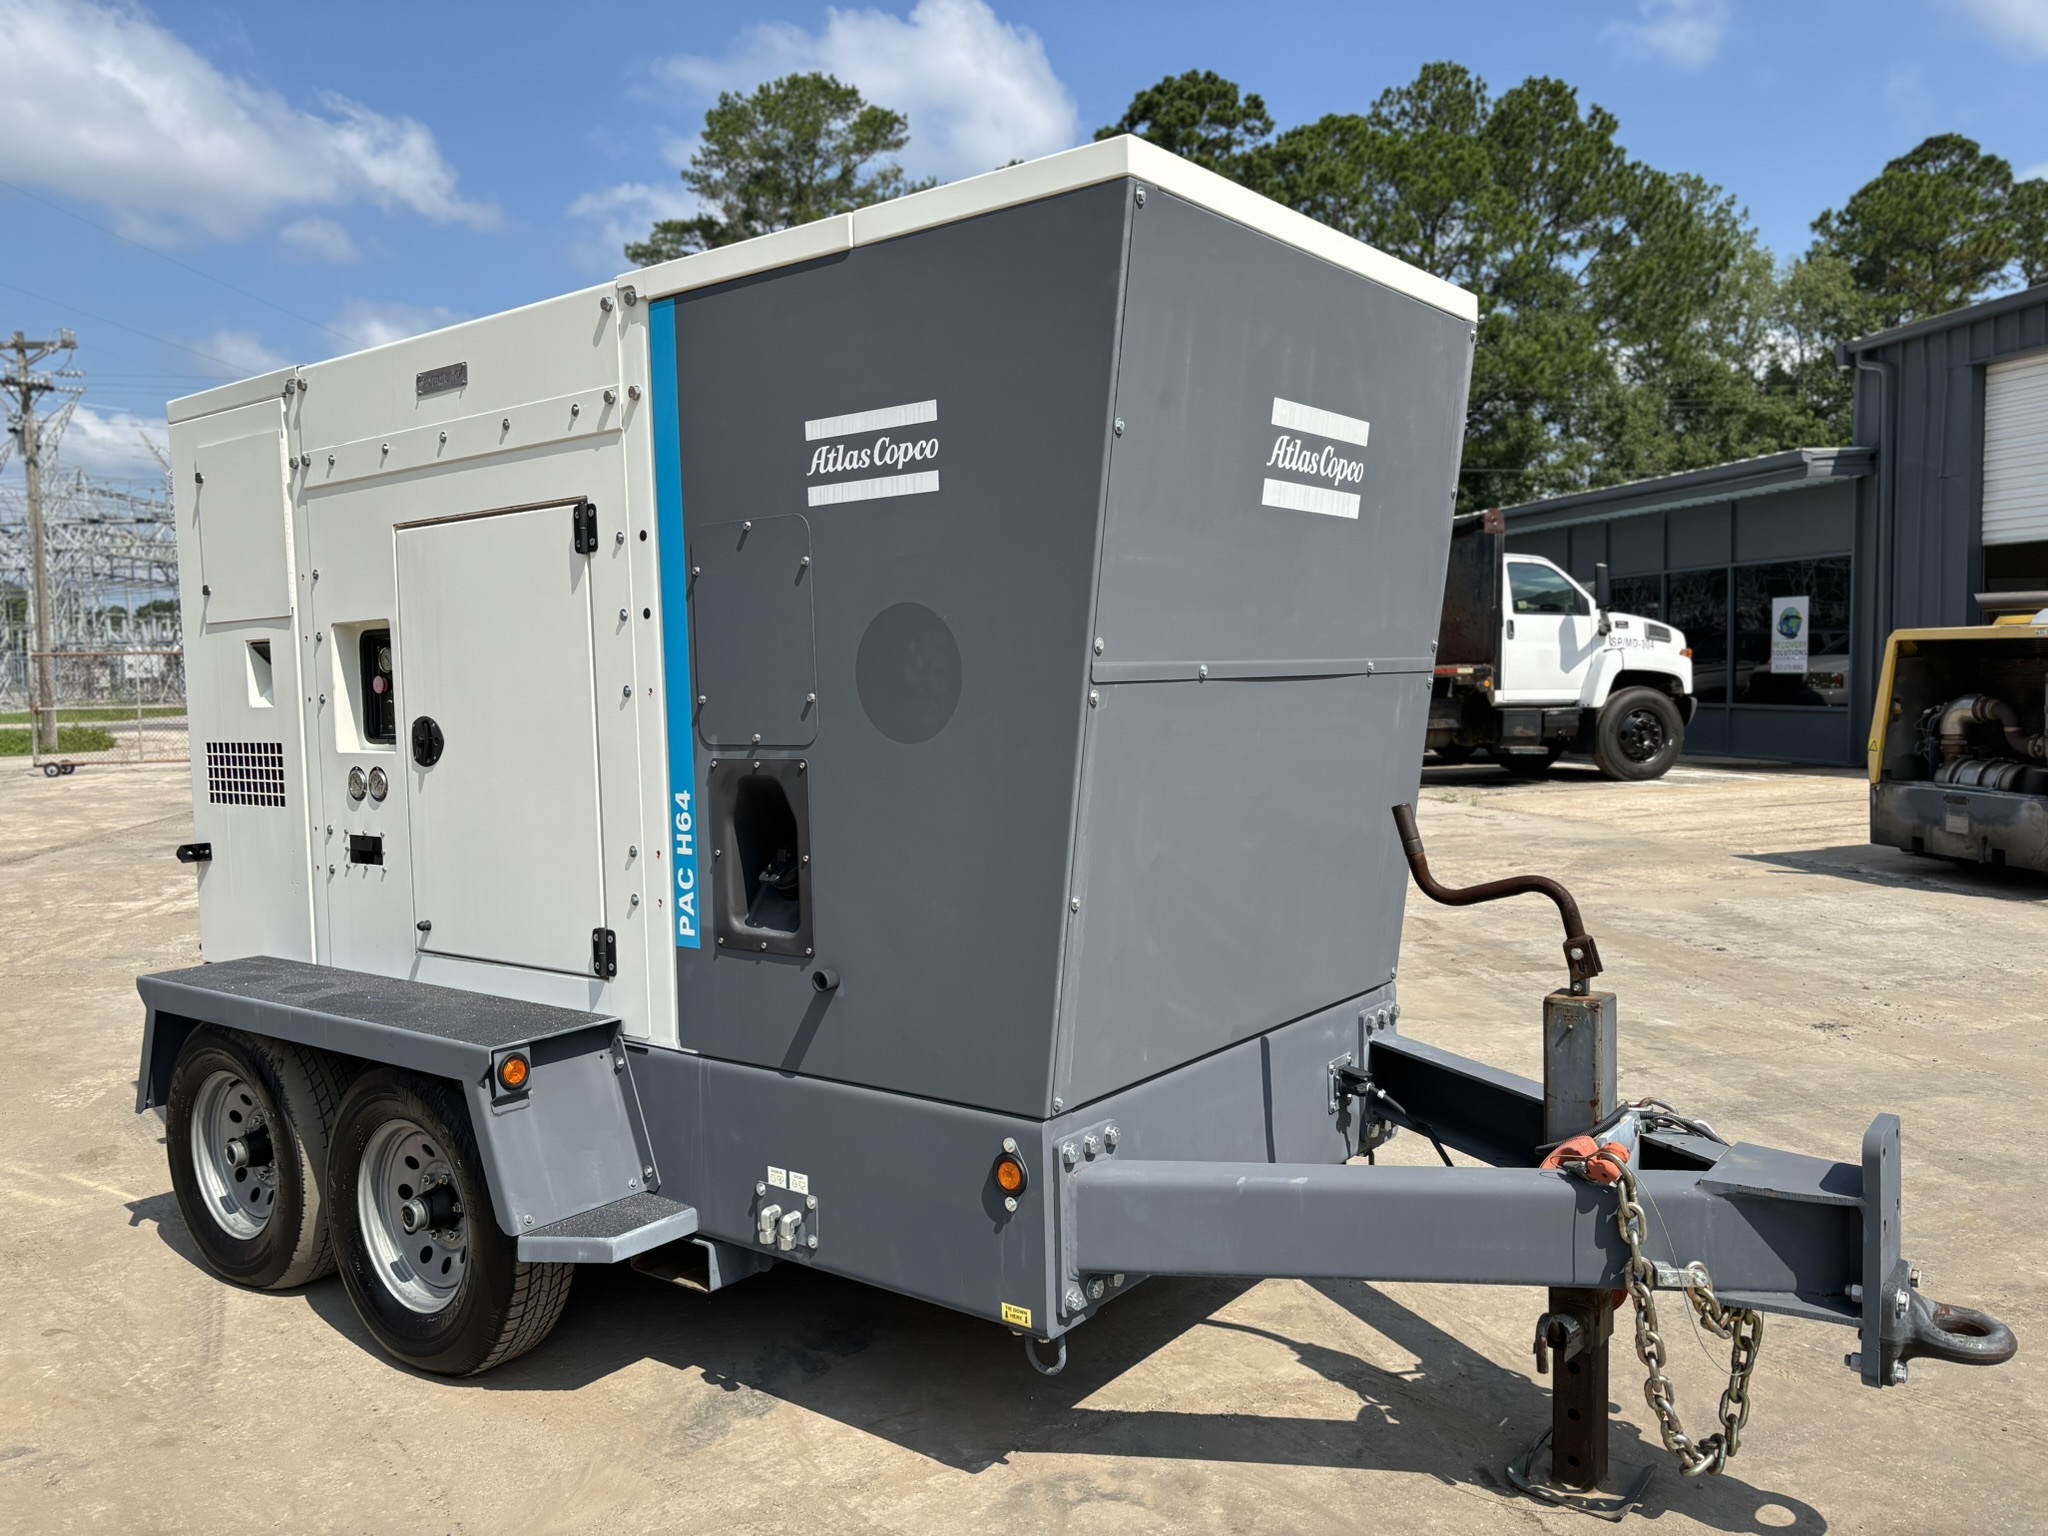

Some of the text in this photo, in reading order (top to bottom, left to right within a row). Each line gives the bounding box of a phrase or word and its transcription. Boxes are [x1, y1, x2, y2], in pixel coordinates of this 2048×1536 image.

[806, 436, 939, 476] Atlas Copco
[1266, 435, 1364, 486] Atlas Copco
[1772, 641, 1807, 649] RECOVERY
[674, 790, 696, 936] PAC H64
[1010, 1313, 1023, 1321] HERE
[1013, 1307, 1027, 1316] DOWN
